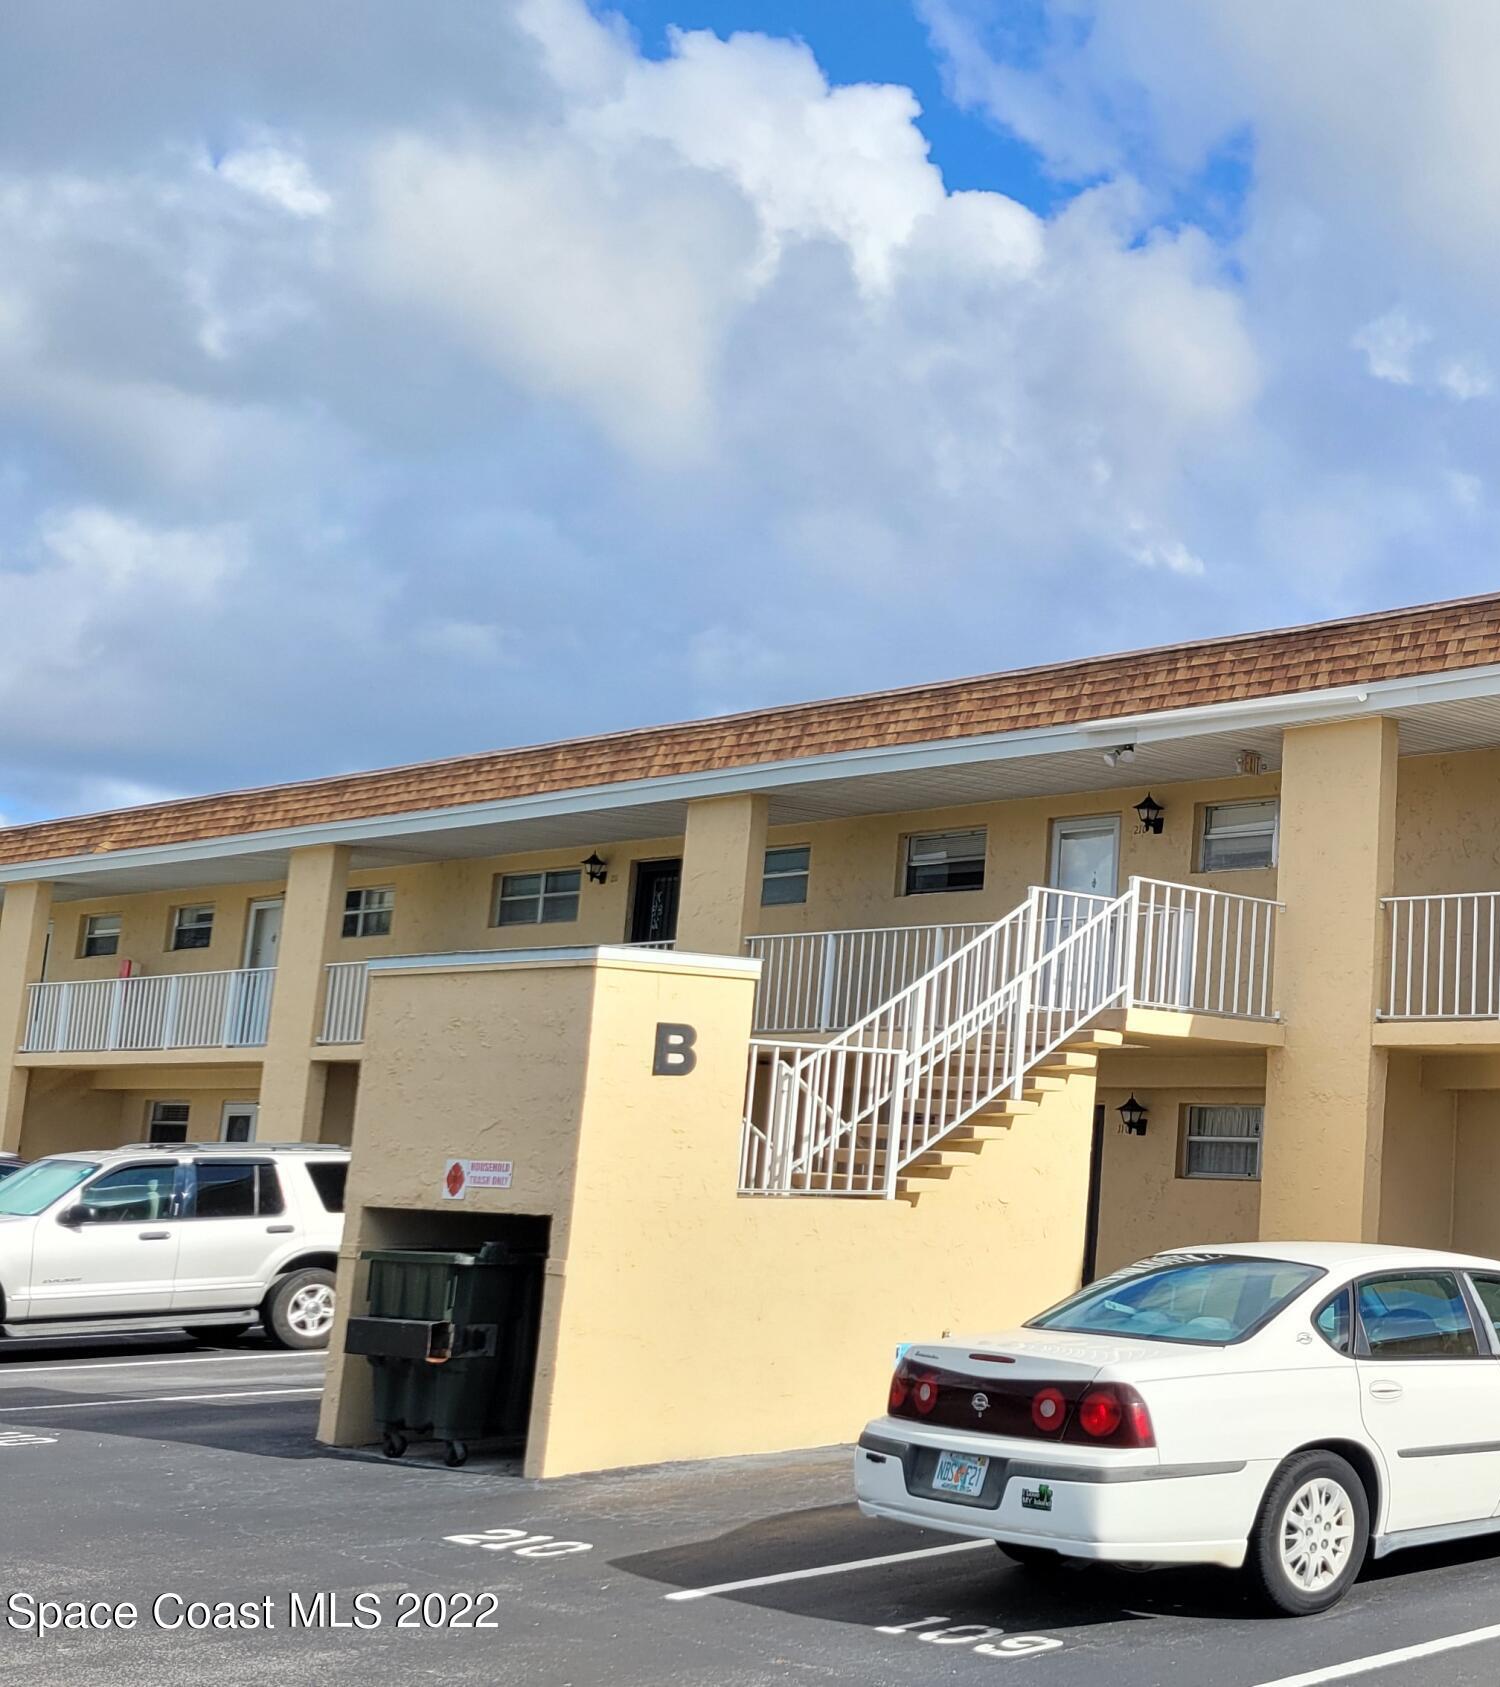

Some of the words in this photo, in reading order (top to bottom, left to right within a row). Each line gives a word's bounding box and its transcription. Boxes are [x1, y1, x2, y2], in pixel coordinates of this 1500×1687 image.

[652, 1022, 698, 1076] B
[470, 1162, 511, 1173] HOUSEHOLD
[492, 1176, 509, 1186] ONLY
[442, 1529, 594, 1557] 210
[873, 1616, 1064, 1656] 109
